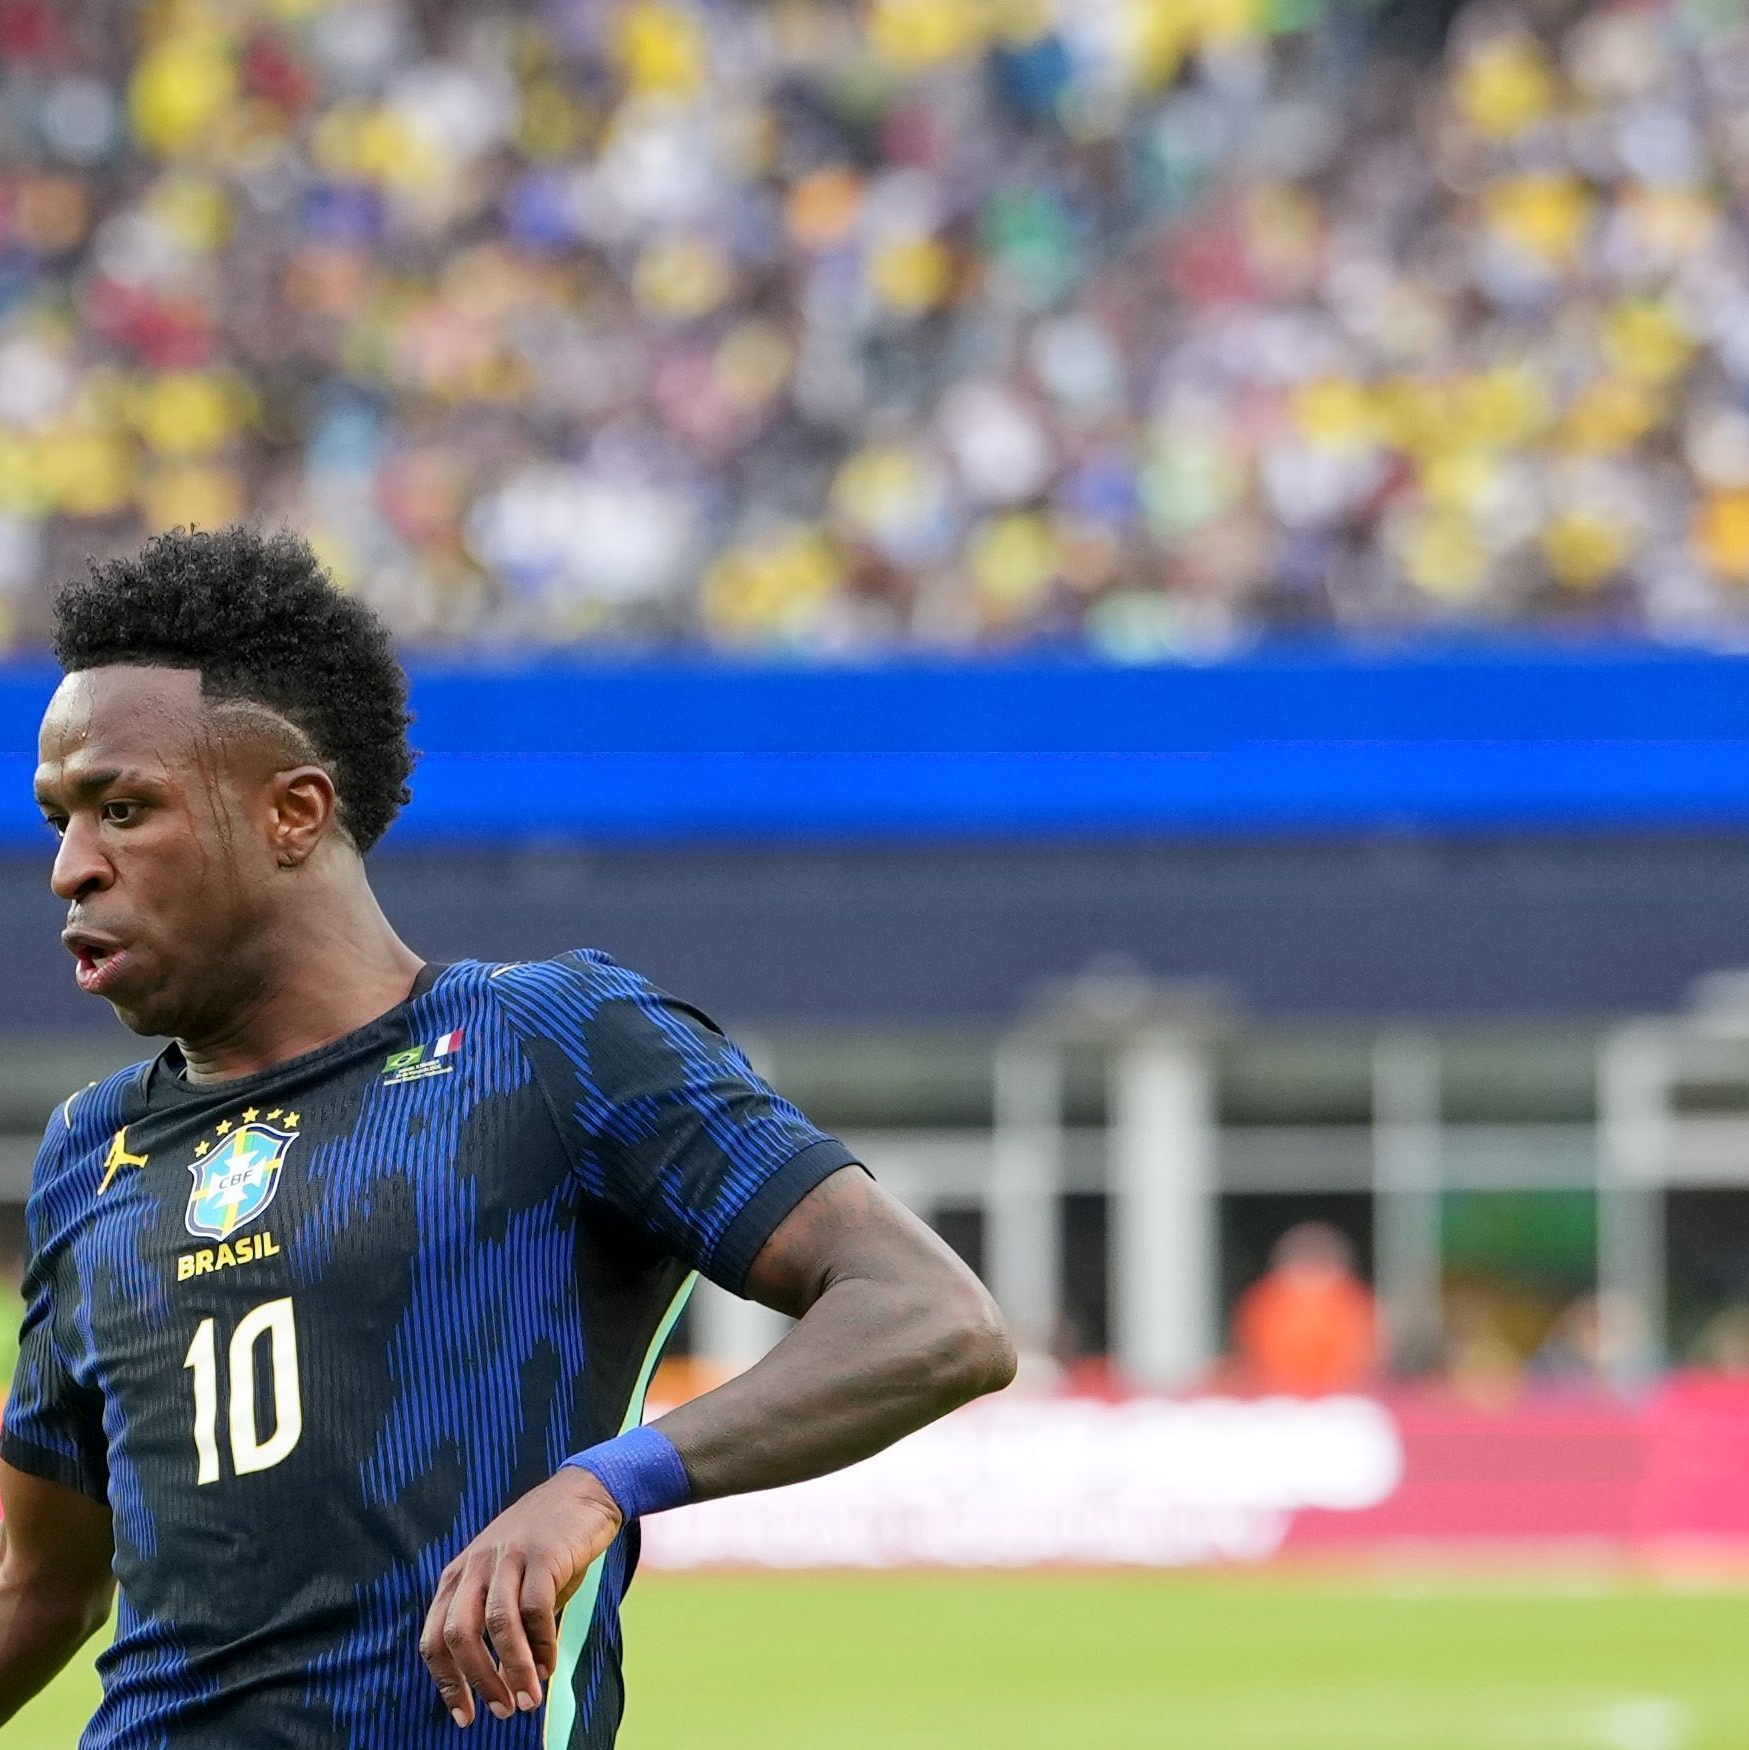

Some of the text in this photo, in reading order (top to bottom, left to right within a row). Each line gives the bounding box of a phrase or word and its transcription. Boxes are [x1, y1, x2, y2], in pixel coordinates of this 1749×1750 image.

[219, 1169, 254, 1189] CBF
[177, 1231, 280, 1282] BRASIL
[183, 1297, 302, 1486] 10
